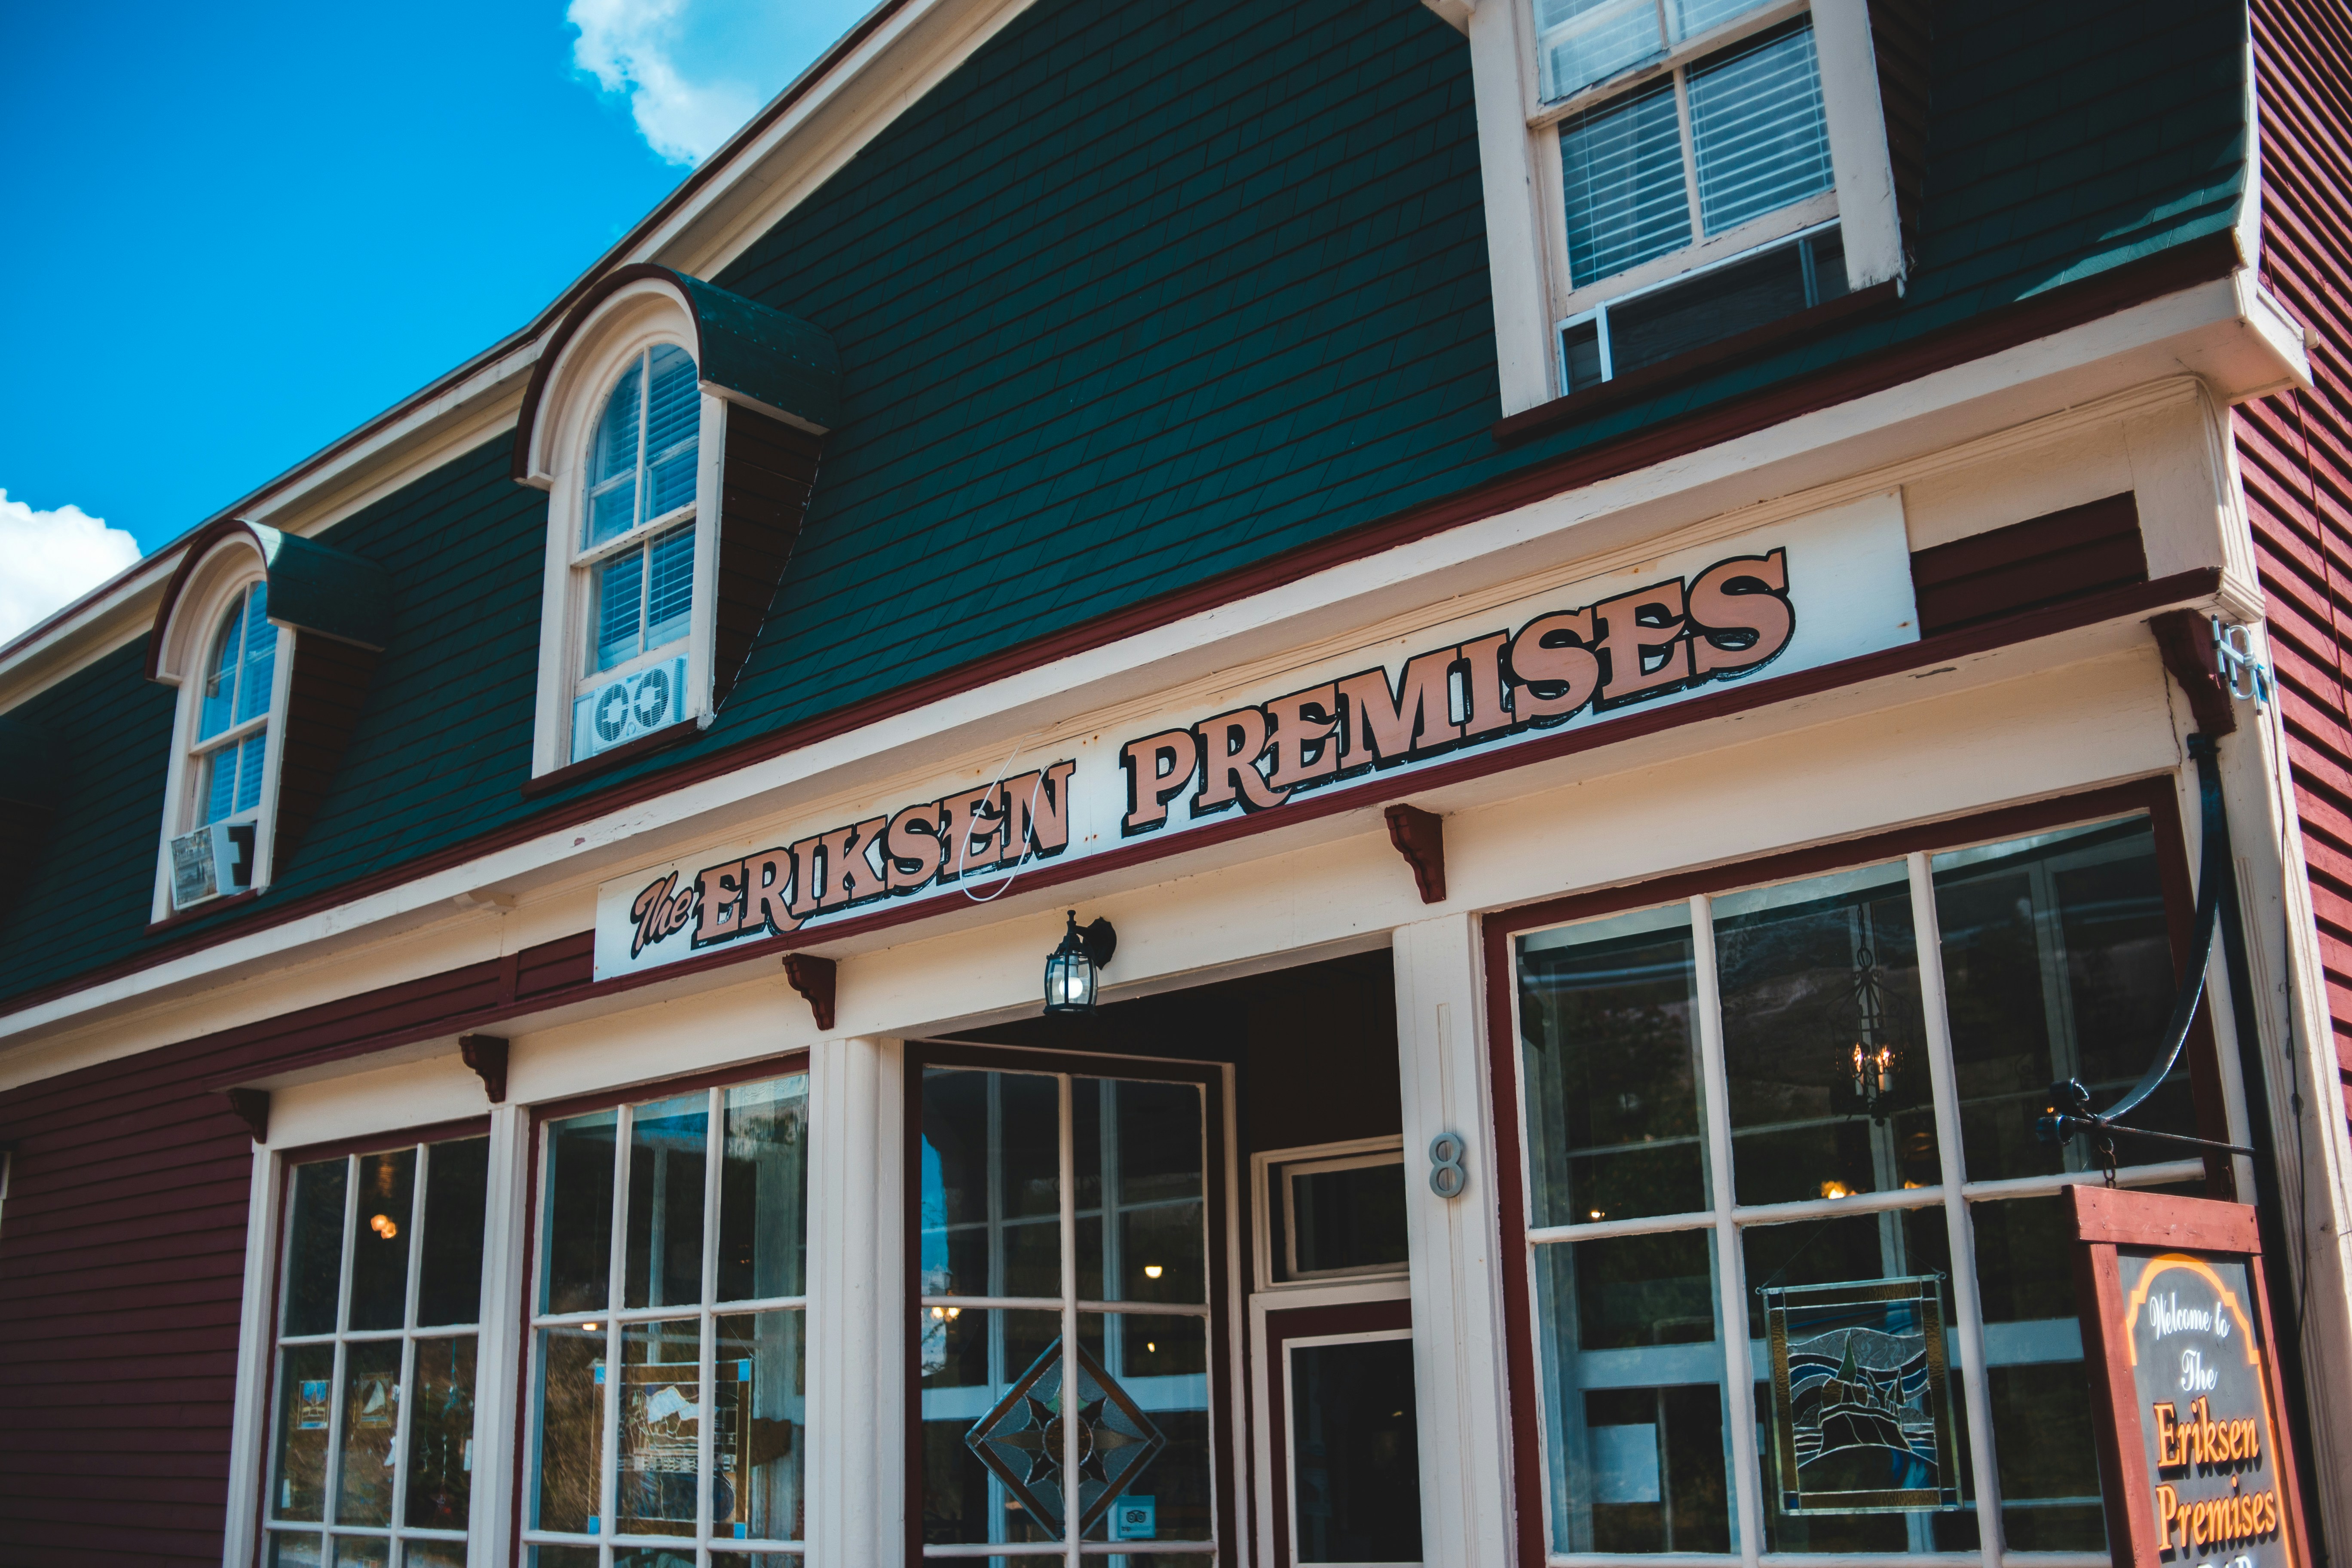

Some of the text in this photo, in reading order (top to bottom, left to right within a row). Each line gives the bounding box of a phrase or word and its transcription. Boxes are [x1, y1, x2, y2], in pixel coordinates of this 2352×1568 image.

[631, 547, 1795, 959] The ERIKSEN PREMISES
[1429, 1133, 1465, 1198] 8
[2150, 1292, 2230, 1340] Welcome to
[2181, 1349, 2218, 1391] The
[2153, 1396, 2259, 1468] Eriksen
[2156, 1478, 2277, 1551] Premises
